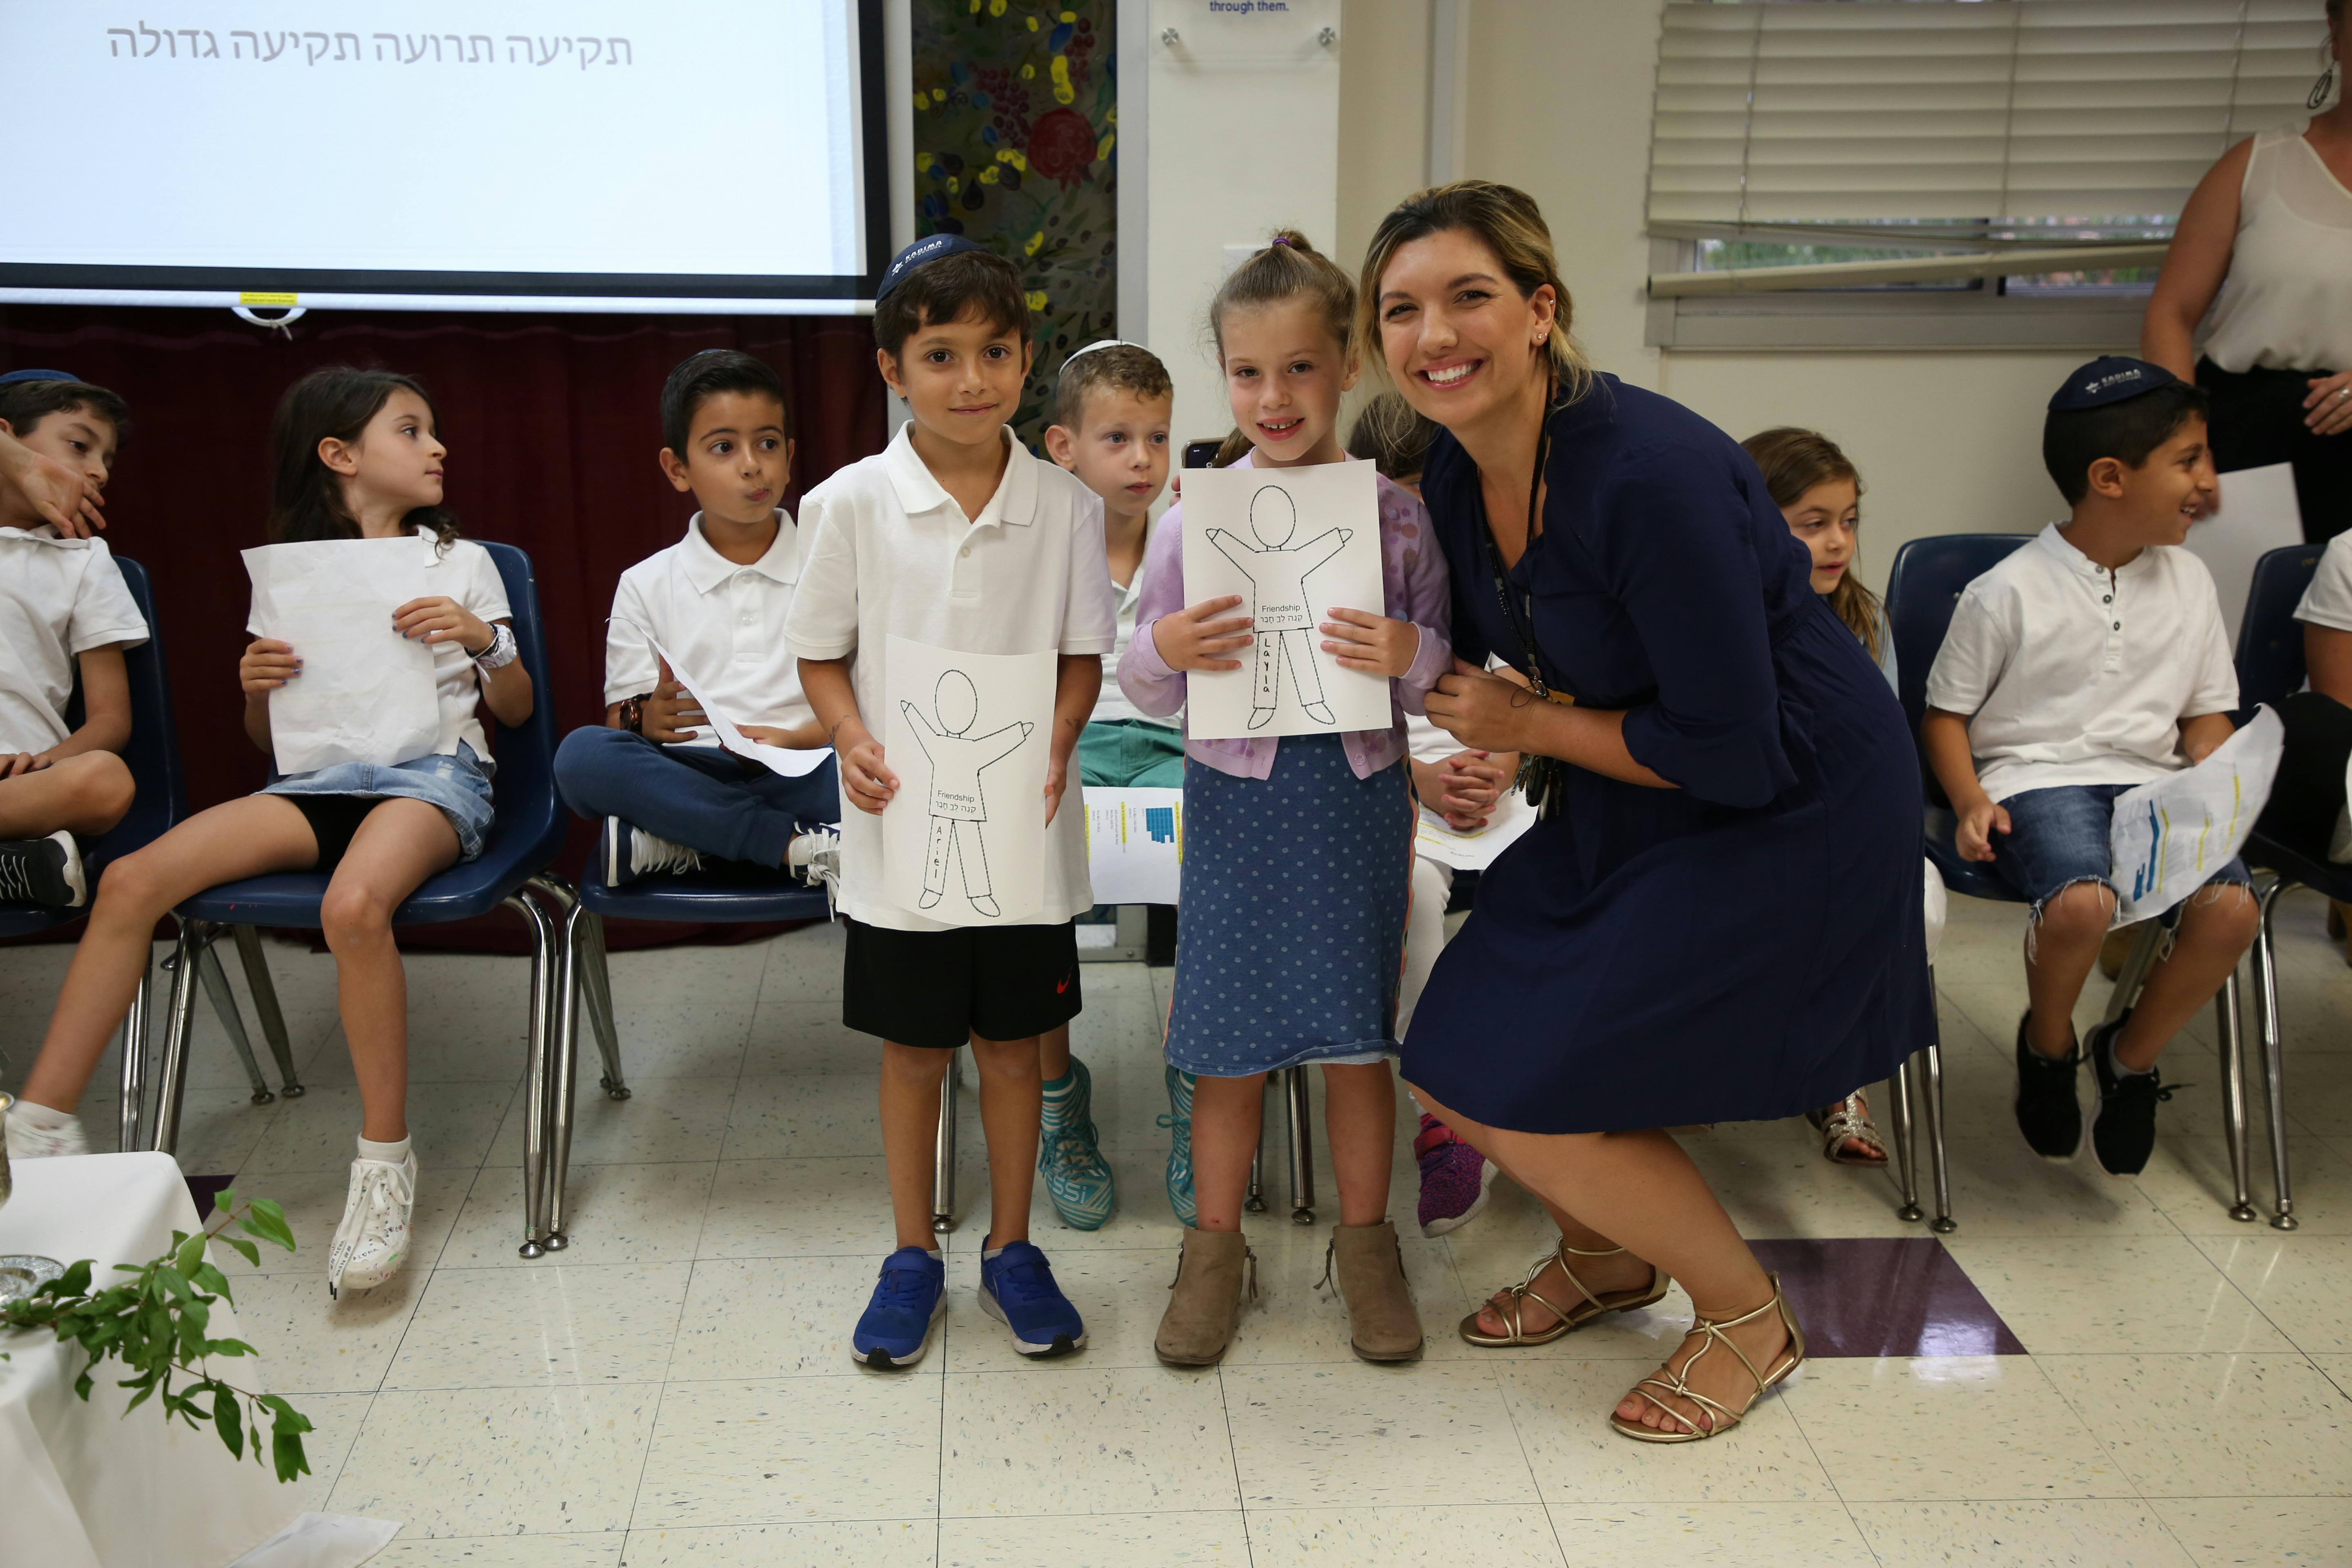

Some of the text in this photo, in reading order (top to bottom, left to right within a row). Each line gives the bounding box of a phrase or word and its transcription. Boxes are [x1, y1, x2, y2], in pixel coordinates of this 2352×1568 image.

[1209, 0, 1289, 14] through them.
[107, 20, 632, 71] תקיעה תרועה תקיעה גדולה
[905, 240, 942, 261] KADIMA
[1262, 604, 1301, 612] Friendship
[938, 790, 975, 804] Friendship
